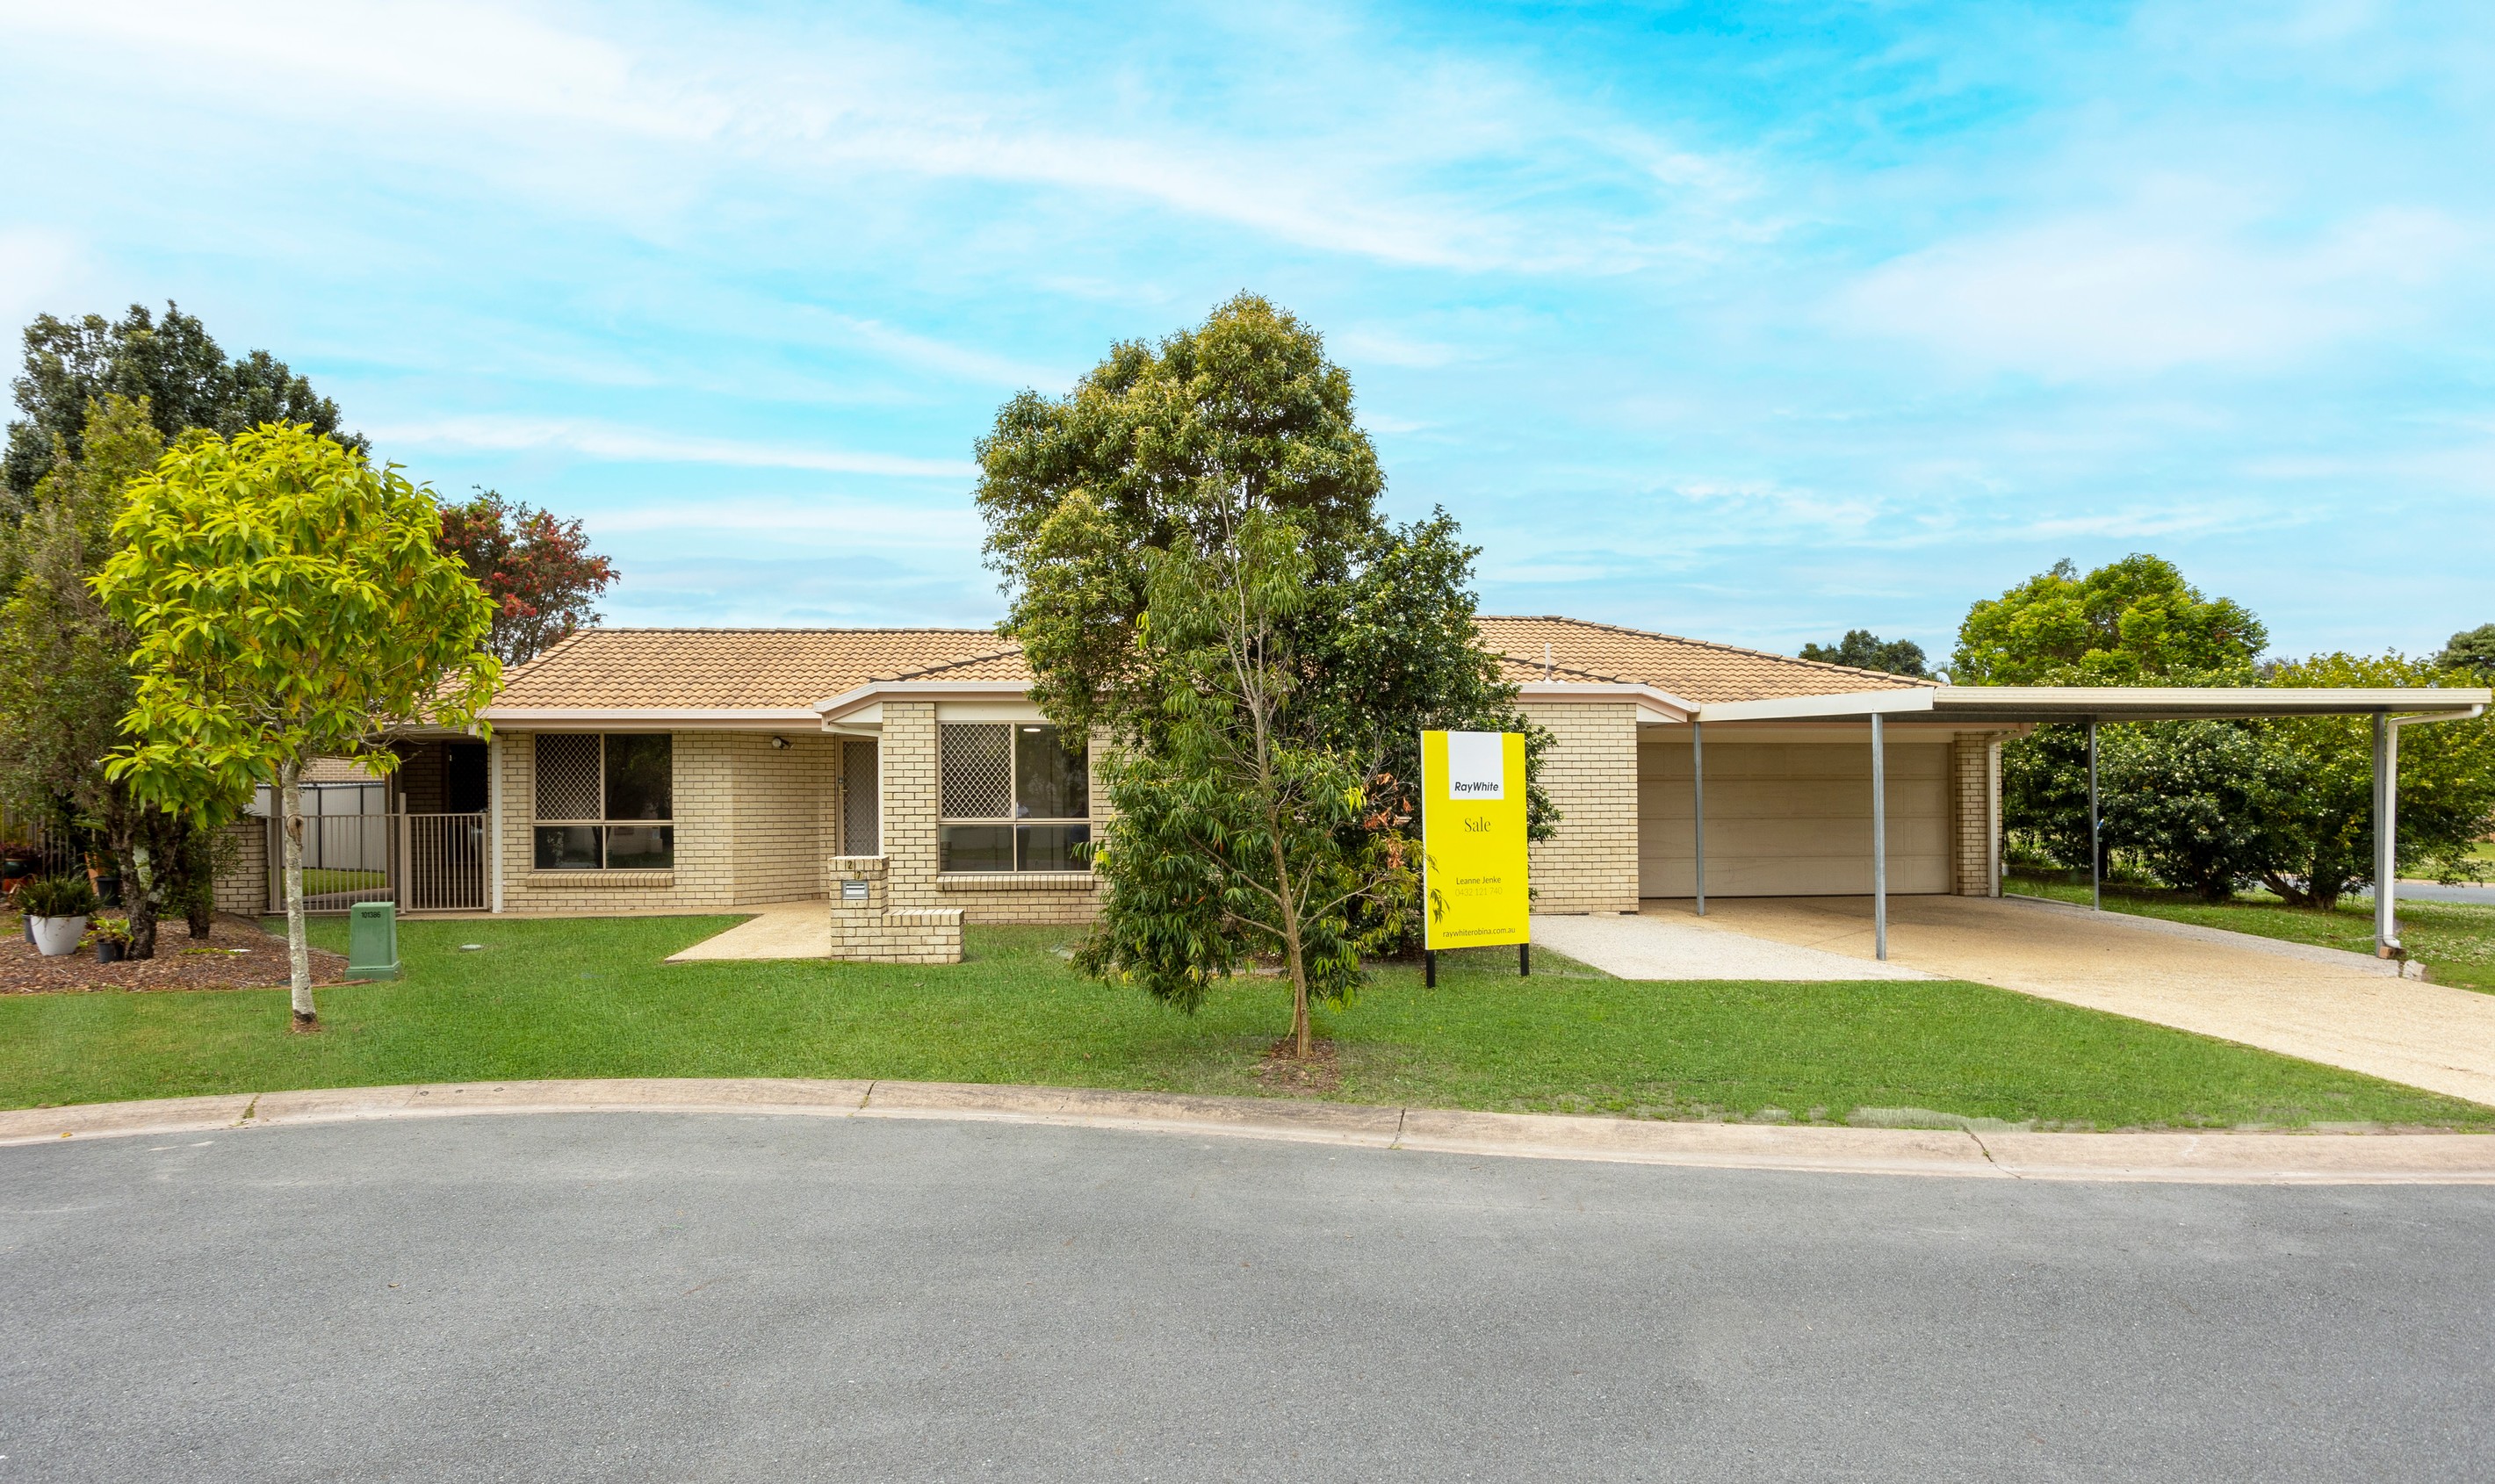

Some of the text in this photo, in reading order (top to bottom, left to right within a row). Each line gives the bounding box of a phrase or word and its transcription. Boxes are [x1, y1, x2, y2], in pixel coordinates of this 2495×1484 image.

[1454, 782, 1499, 793] RayWhite
[1464, 817, 1491, 832] Sale
[1443, 927, 1516, 938] raywhiterobina.com.au
